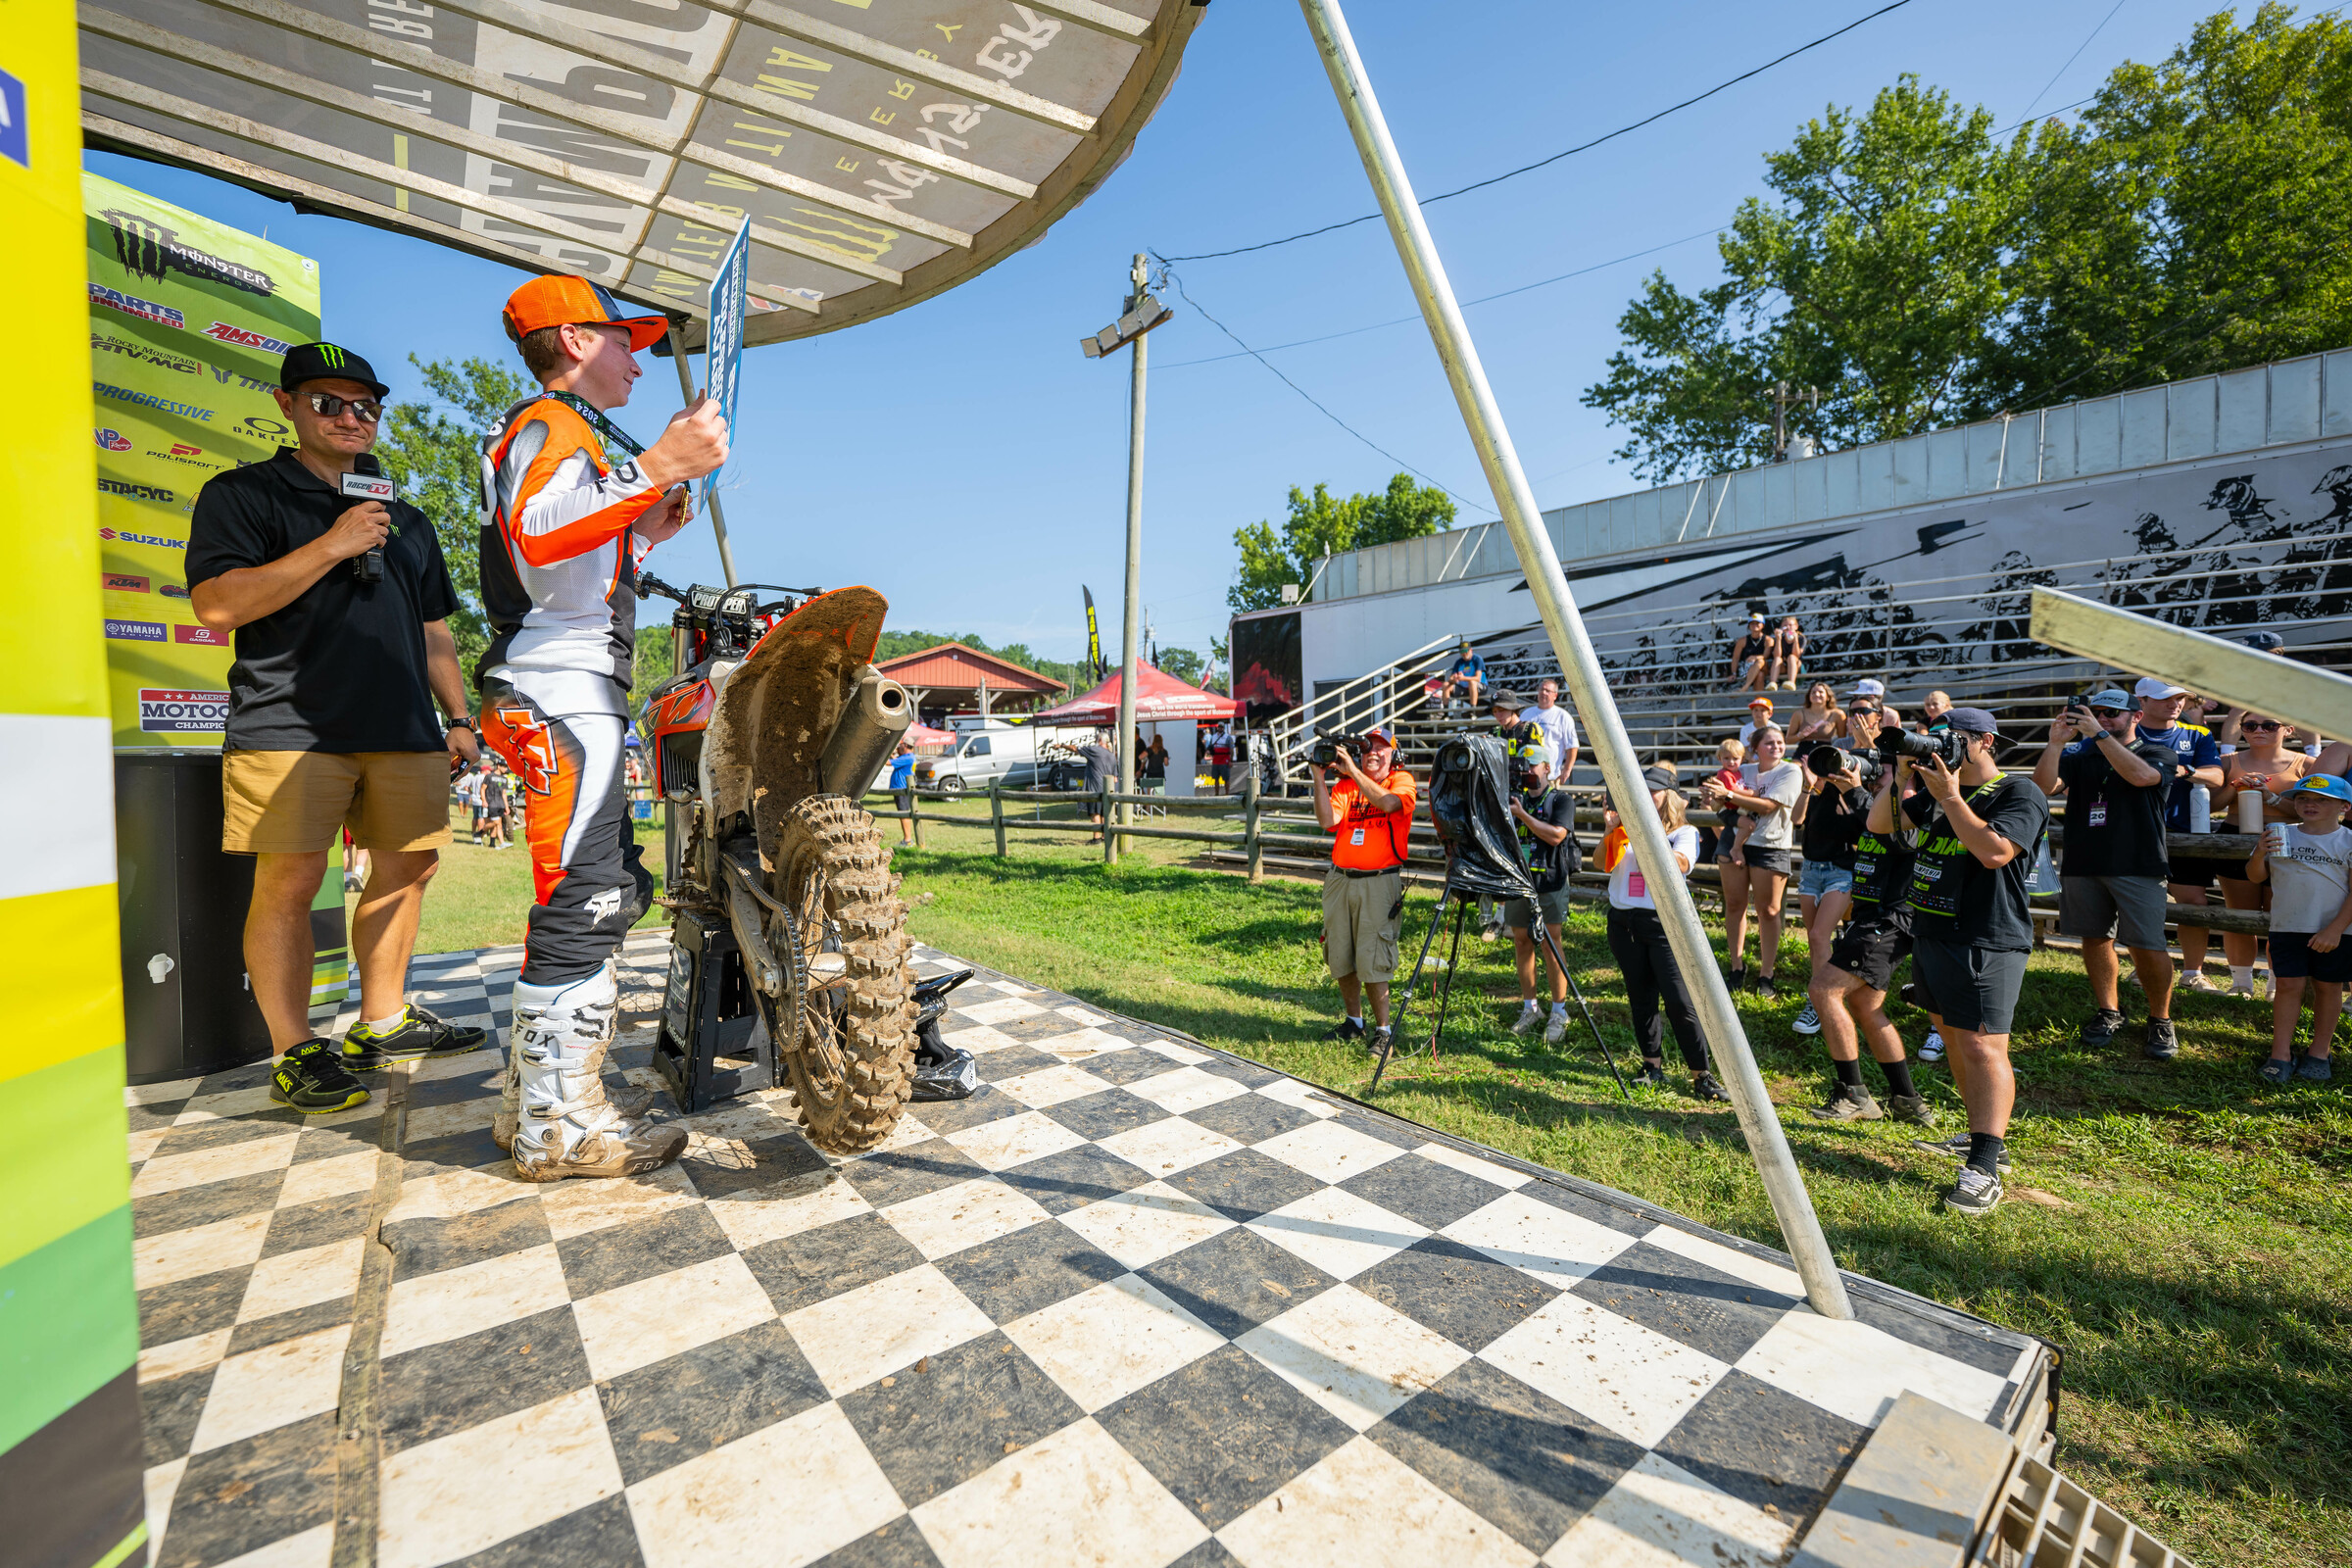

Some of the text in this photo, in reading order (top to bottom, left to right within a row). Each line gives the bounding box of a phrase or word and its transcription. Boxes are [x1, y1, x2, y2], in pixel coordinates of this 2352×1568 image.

[169, 243, 269, 289] MONSTER
[184, 263, 253, 290] ENERGY
[87, 281, 184, 322] PARTS
[88, 294, 184, 329] UNLIMITED
[107, 335, 196, 367] ROCKY MOUNTAIN
[93, 381, 216, 422] PROGRESSIVE
[575, 400, 599, 425] 2024
[94, 427, 120, 450] VP
[232, 425, 300, 447] OAKLEY
[97, 477, 174, 504] STACYC
[120, 531, 188, 551] SUZUK
[108, 577, 141, 589] KTM
[694, 592, 745, 612] PROTPER
[119, 624, 162, 636] YAMAHA
[189, 693, 229, 702] AMERIC
[1917, 830, 1959, 856] MDIA
[2297, 846, 2317, 856] City
[514, 1023, 556, 1048] FOX
[300, 1042, 322, 1057] MKS
[275, 1070, 294, 1094] MKS
[631, 1159, 664, 1172] FOX
